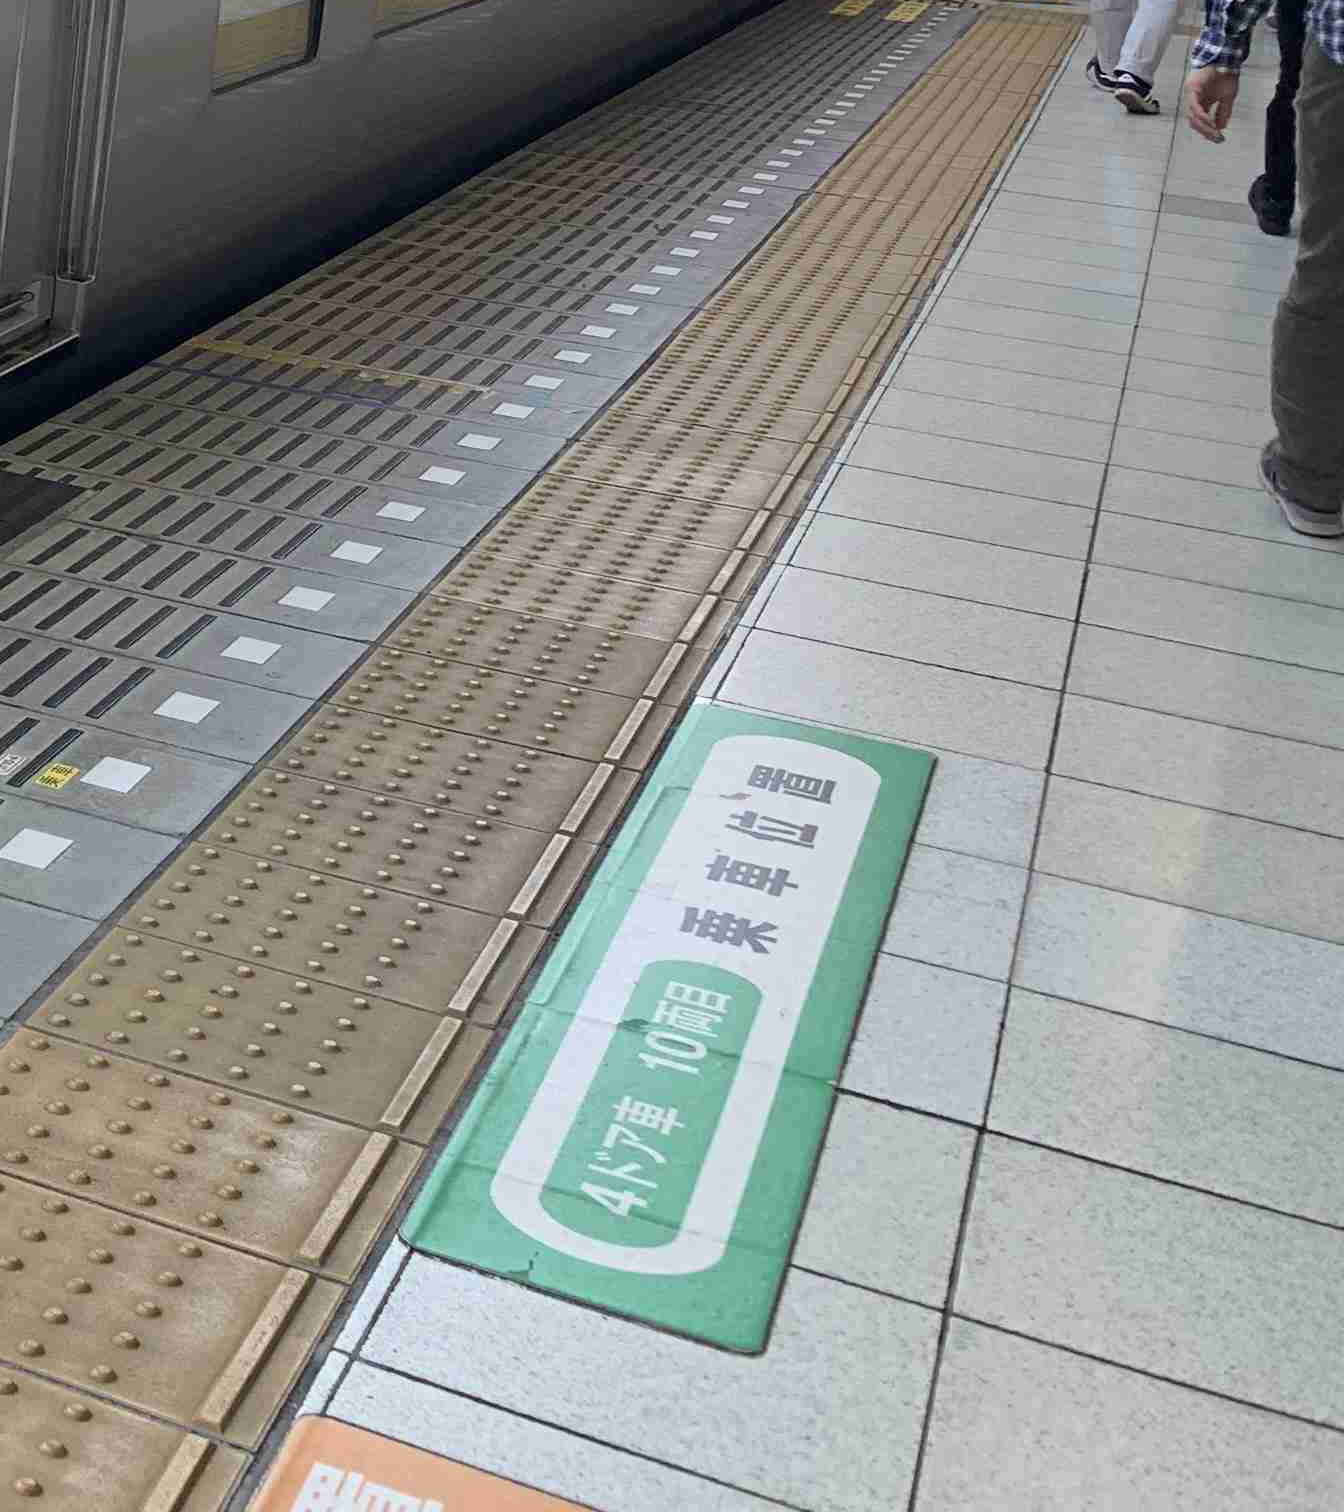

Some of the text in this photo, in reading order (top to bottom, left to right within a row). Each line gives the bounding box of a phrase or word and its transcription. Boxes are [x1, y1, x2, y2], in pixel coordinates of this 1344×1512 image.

[679, 763, 838, 955] 乗車位置
[580, 980, 733, 1217] 4ドア車 10両目
